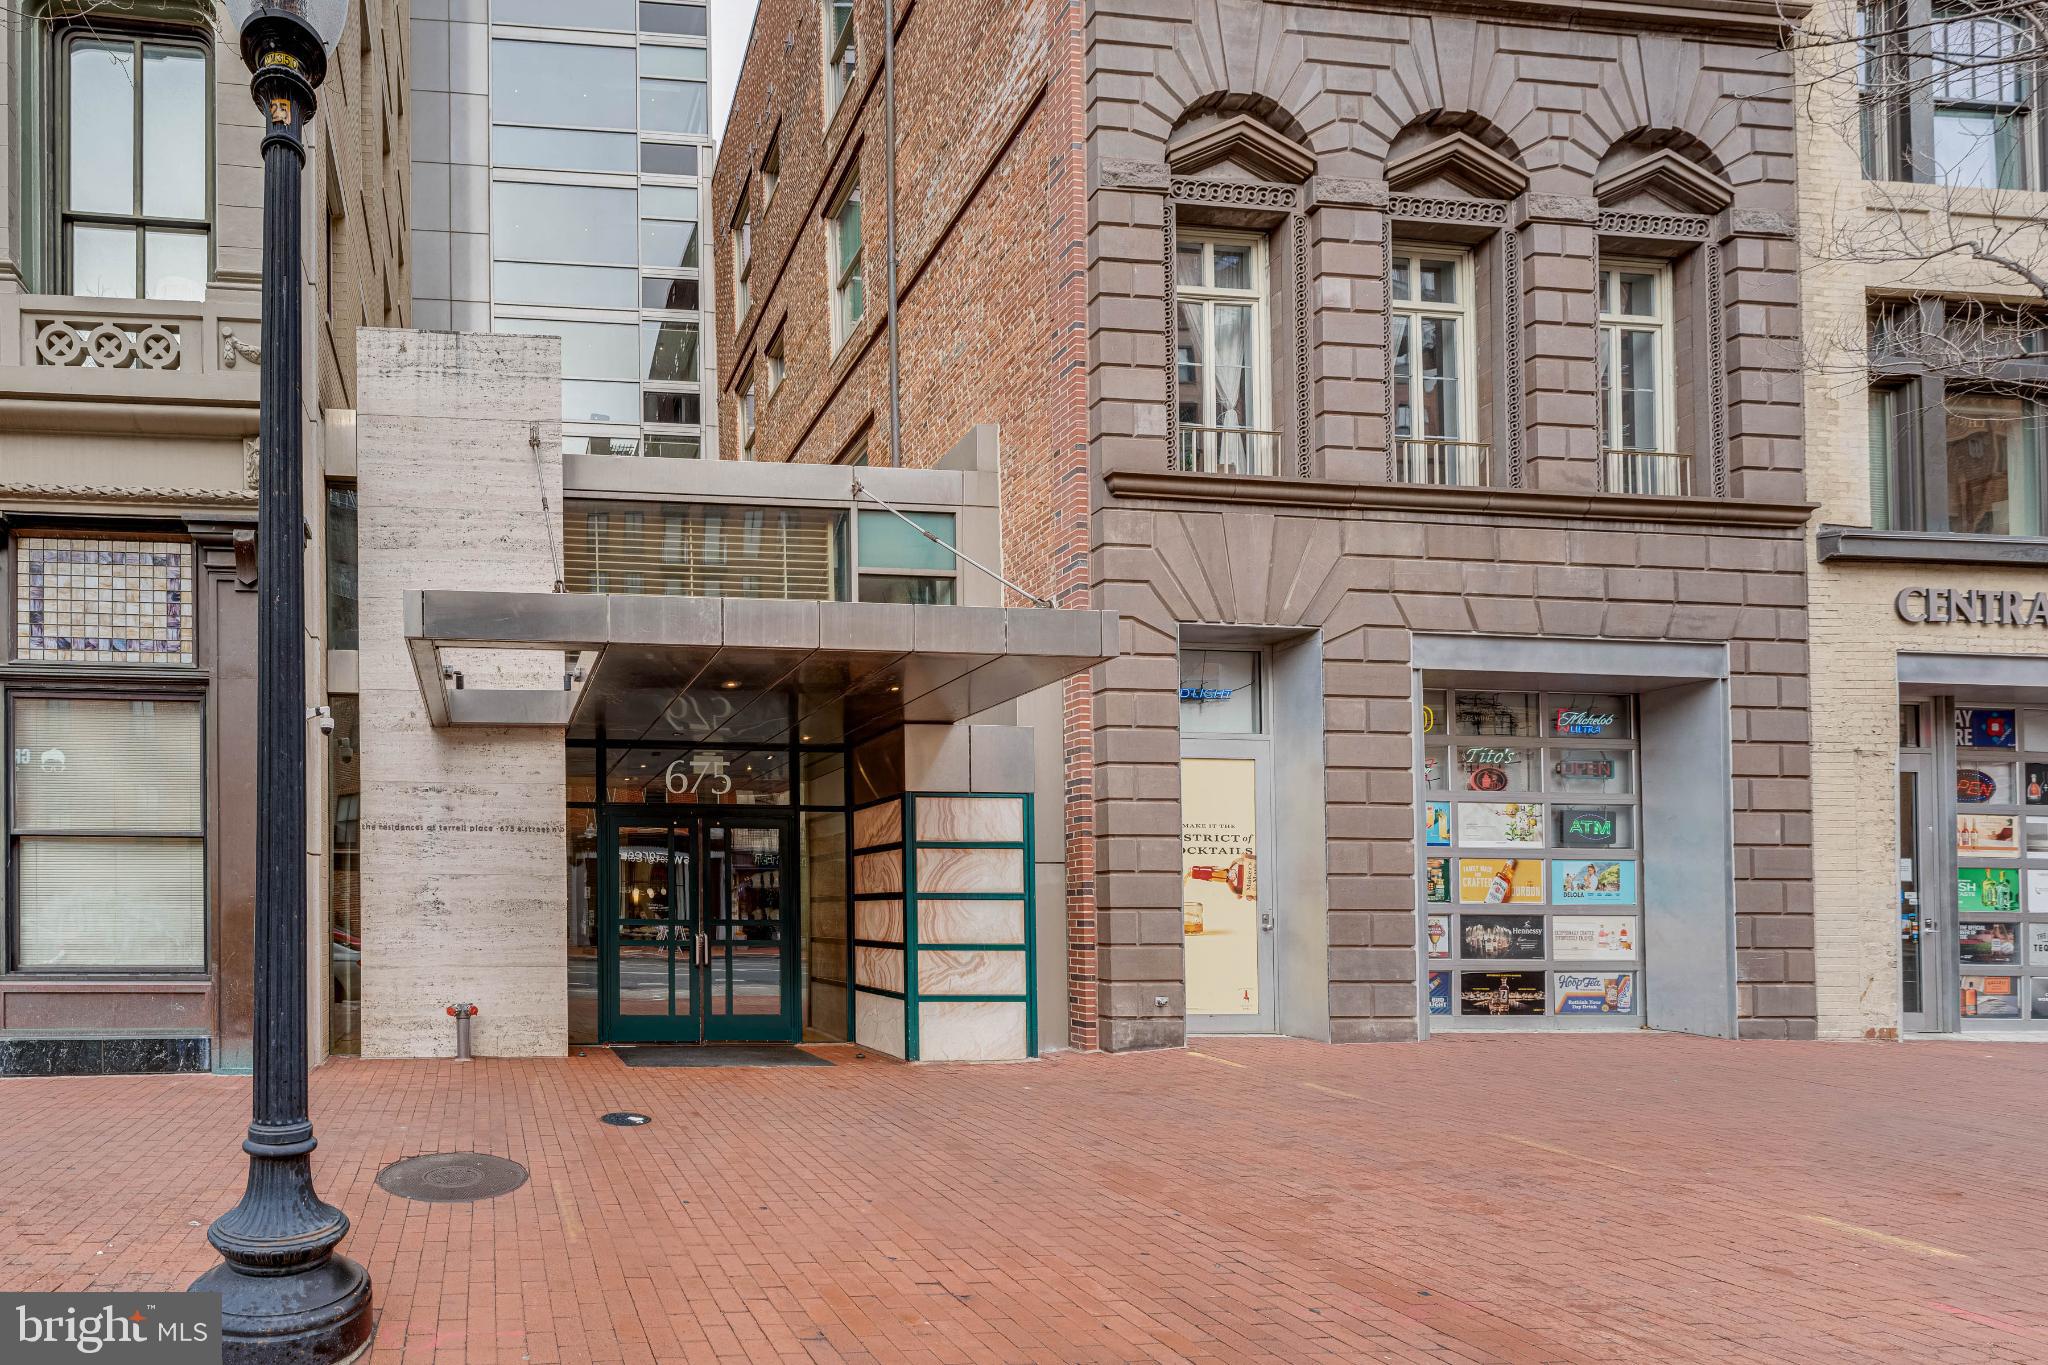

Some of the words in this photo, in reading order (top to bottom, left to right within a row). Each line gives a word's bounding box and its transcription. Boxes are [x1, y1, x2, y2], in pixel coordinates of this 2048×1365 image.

[1896, 587, 2048, 625] CENTRA
[1558, 711, 1615, 726] Michelob
[1466, 747, 1515, 763] Tito's
[665, 759, 732, 795] 675
[361, 822, 376, 831] the
[378, 822, 424, 832] residences
[427, 823, 437, 832] at
[469, 823, 494, 833] place
[499, 825, 515, 833] 675
[1569, 819, 1611, 835] ATM
[1242, 834, 1254, 844] of
[1512, 927, 1543, 936] Hennessy
[1558, 974, 1583, 991] Hoop
[1582, 976, 1601, 988] Tea
